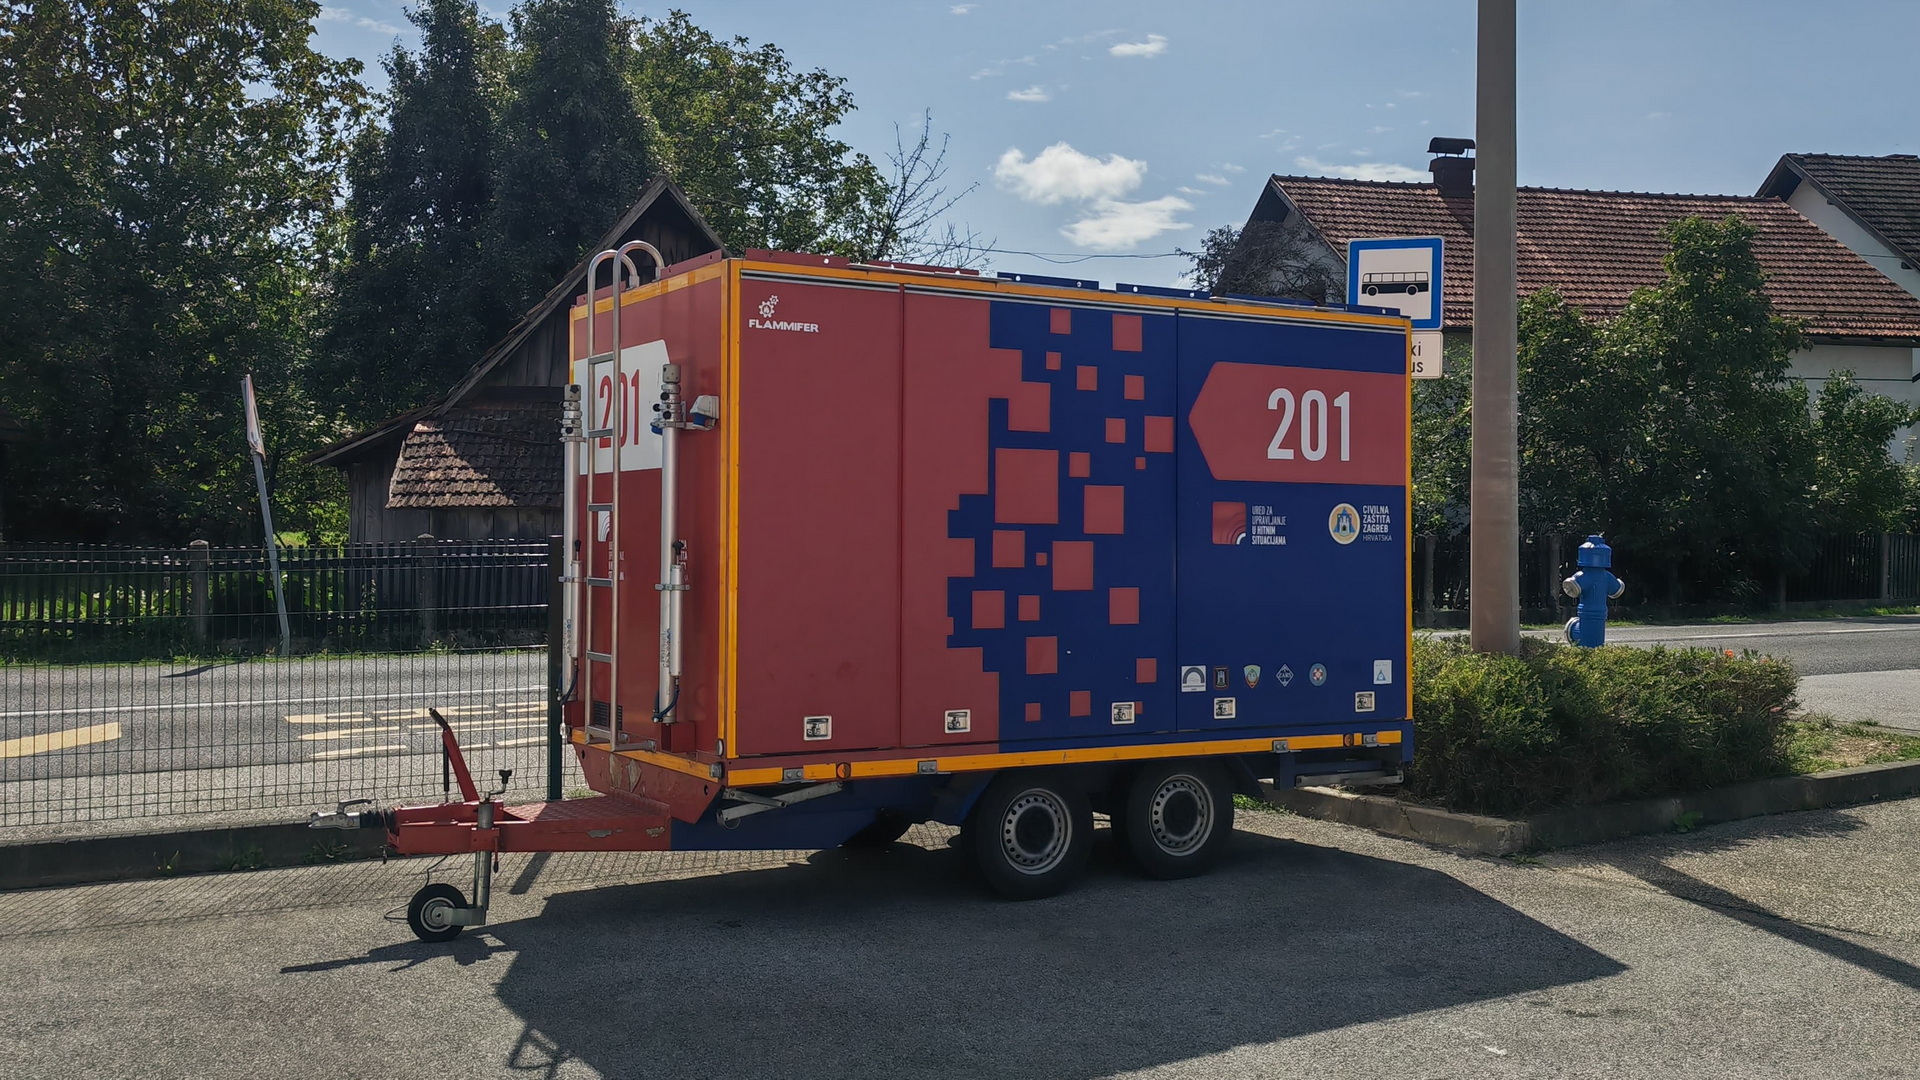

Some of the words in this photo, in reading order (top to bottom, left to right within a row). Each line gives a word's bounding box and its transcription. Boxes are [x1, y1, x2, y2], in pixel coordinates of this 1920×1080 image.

[748, 318, 819, 333] FLAMMIFER
[1267, 387, 1350, 462] 201
[1266, 505, 1273, 515] ZA
[1362, 505, 1390, 515] CIVILNA
[1362, 513, 1391, 524] ZAŠTITA
[1251, 525, 1257, 535] U
[1362, 524, 1389, 533] ZAGREB
[1251, 535, 1287, 546] SITUACIJAMA
[1362, 534, 1393, 542] HRVATSKA
